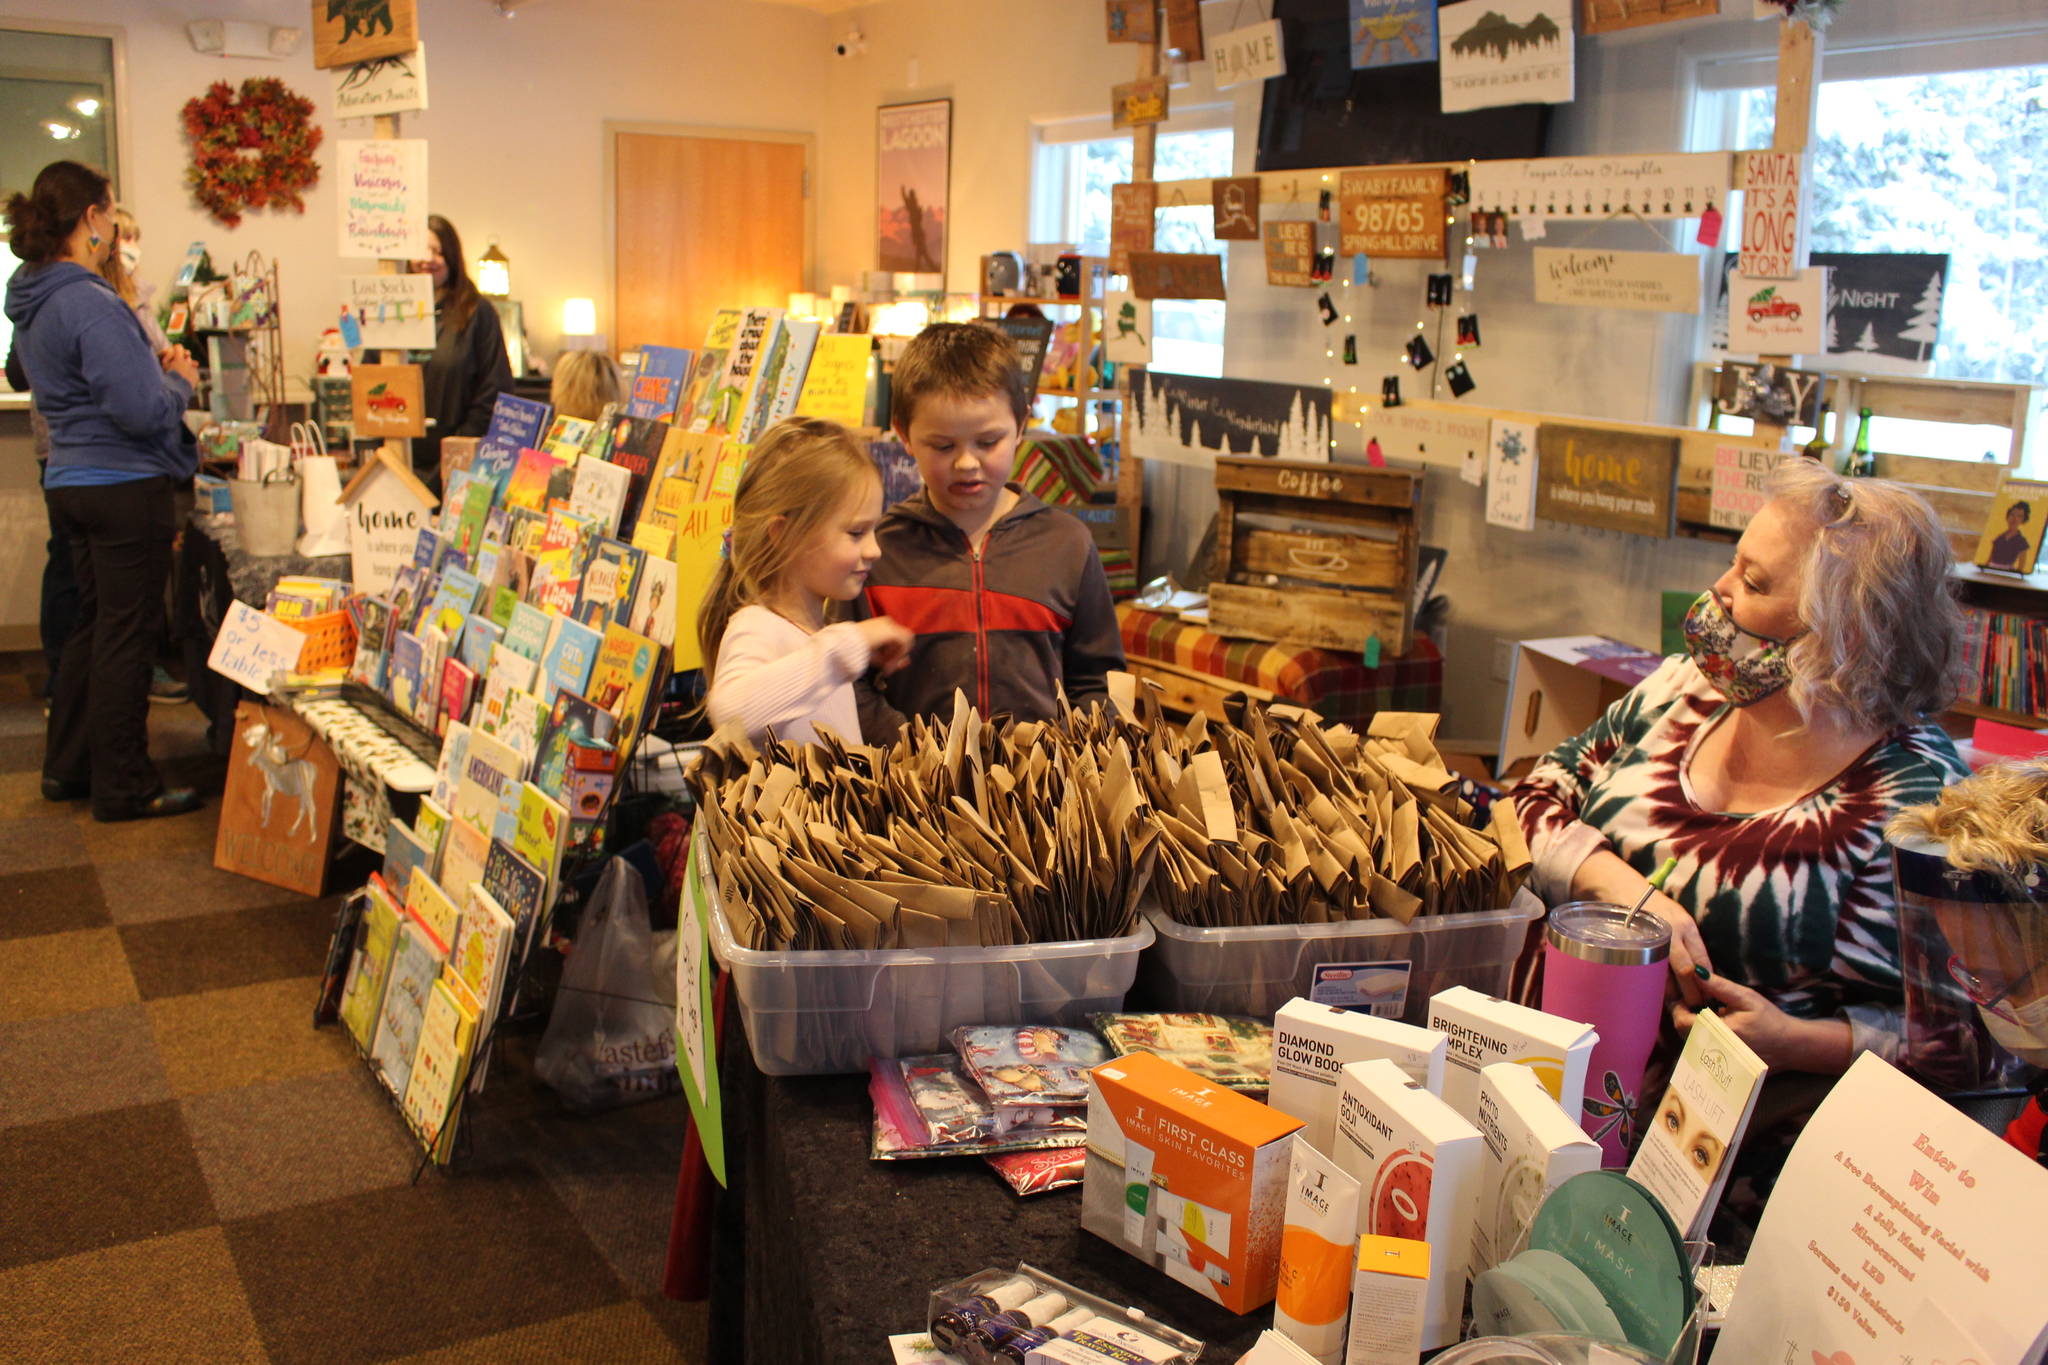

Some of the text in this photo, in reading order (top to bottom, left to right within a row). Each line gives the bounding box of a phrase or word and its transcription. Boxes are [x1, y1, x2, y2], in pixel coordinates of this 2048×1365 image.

[1214, 36, 1275, 73] HME
[1391, 176, 1440, 194] FAMILY
[1745, 188, 1797, 209] IT'S A
[1355, 202, 1424, 233] 98765
[1741, 211, 1796, 253] LONG
[1404, 234, 1439, 252] DRIVE
[1739, 254, 1791, 276] STORY
[352, 279, 415, 295] Lost Socks
[1840, 288, 1900, 310] NIGHT
[1719, 365, 1819, 425] JY
[1565, 439, 1642, 488] home
[1277, 470, 1344, 496] Coffee
[357, 501, 417, 534] home
[682, 508, 709, 539] All
[226, 629, 246, 645] or
[1279, 1031, 1335, 1057] DIAMOND
[1433, 1016, 1508, 1055] BRIGHTENING
[1446, 1036, 1483, 1061] MPLEX
[1278, 1046, 1313, 1066] GLOW
[1314, 1055, 1345, 1075] BOOS
[1699, 1049, 1734, 1090] Lash Stuff
[1169, 1087, 1215, 1108] IMAGE
[1480, 1090, 1499, 1120] PHYTO
[1683, 1073, 1726, 1125] LASH LIFT
[1340, 1104, 1358, 1128] GOJI
[1342, 1090, 1394, 1142] ANTIOXIDANT
[1478, 1106, 1509, 1152] NUTRIENTS
[1126, 1116, 1246, 1169] IMAGE FIRST CLASS
[1157, 1134, 1247, 1181] SKIN FAVORITES
[1912, 1132, 1977, 1189] Enter to
[1300, 1184, 1331, 1214] IMAGE
[1908, 1169, 1942, 1207] Win
[1603, 1213, 1634, 1243] IMAGE
[1834, 1150, 1992, 1284] A free Dermaplaning Facial with
[1863, 1203, 1927, 1262] A Jelly Mask
[1594, 1239, 1635, 1280] MASK
[1807, 1239, 1861, 1293] Serums and
[1851, 1221, 1917, 1283] Microcurrent
[1861, 1258, 1887, 1286] LED
[1851, 1307, 1878, 1340] Value
